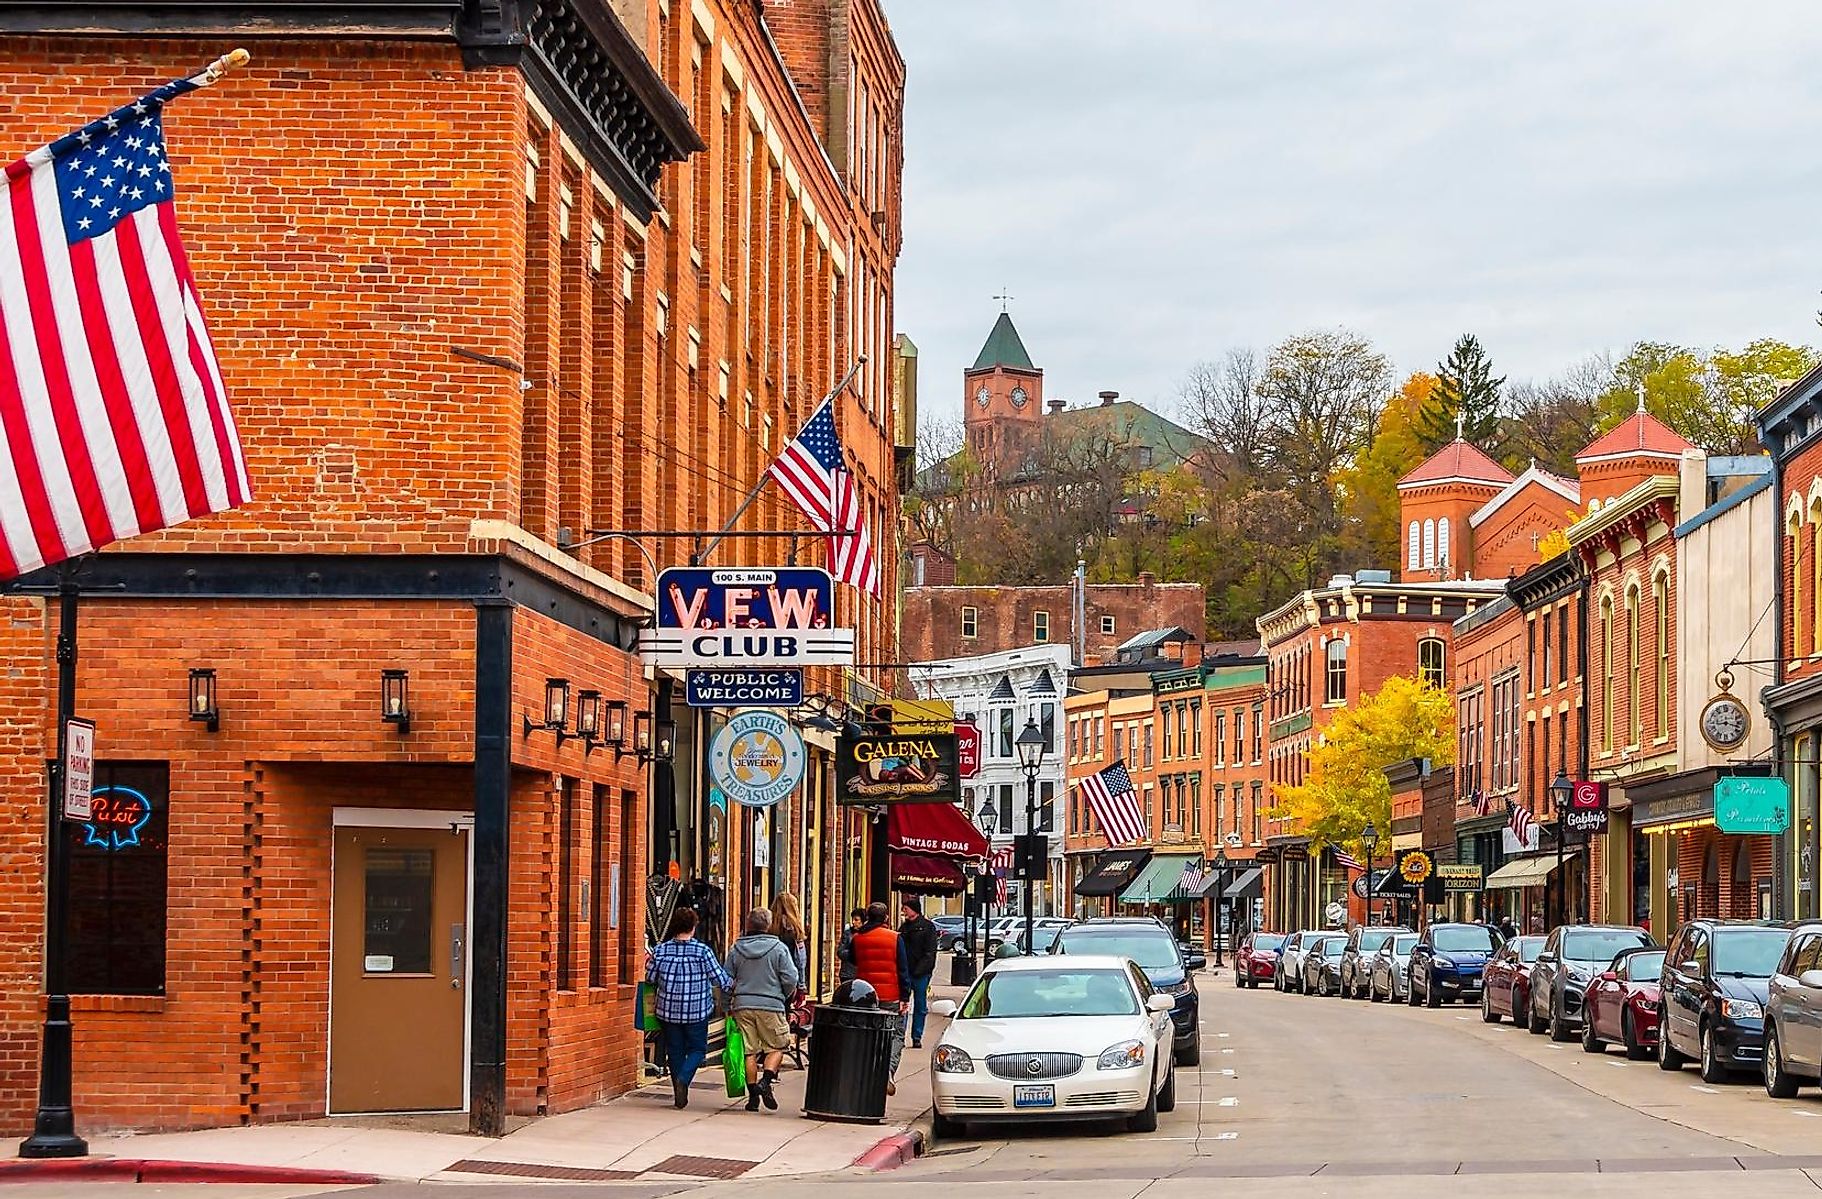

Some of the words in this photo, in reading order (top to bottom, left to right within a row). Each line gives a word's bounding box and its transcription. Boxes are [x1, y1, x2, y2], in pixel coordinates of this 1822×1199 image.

[716, 574, 733, 582] 100
[735, 574, 745, 582] S.
[747, 574, 773, 582] MAIN
[692, 636, 798, 657] CLUB
[710, 674, 780, 686] PUBLIC
[697, 688, 793, 700] WELCOME
[731, 716, 786, 735] EARTH'S
[75, 735, 85, 753] NO
[853, 740, 939, 762] GALENA
[735, 759, 779, 767] JEWELRY
[721, 773, 793, 801] TREASURES
[1567, 810, 1608, 830] Gabby's
[901, 836, 938, 848] VINTAGE
[941, 840, 969, 851] SODAS
